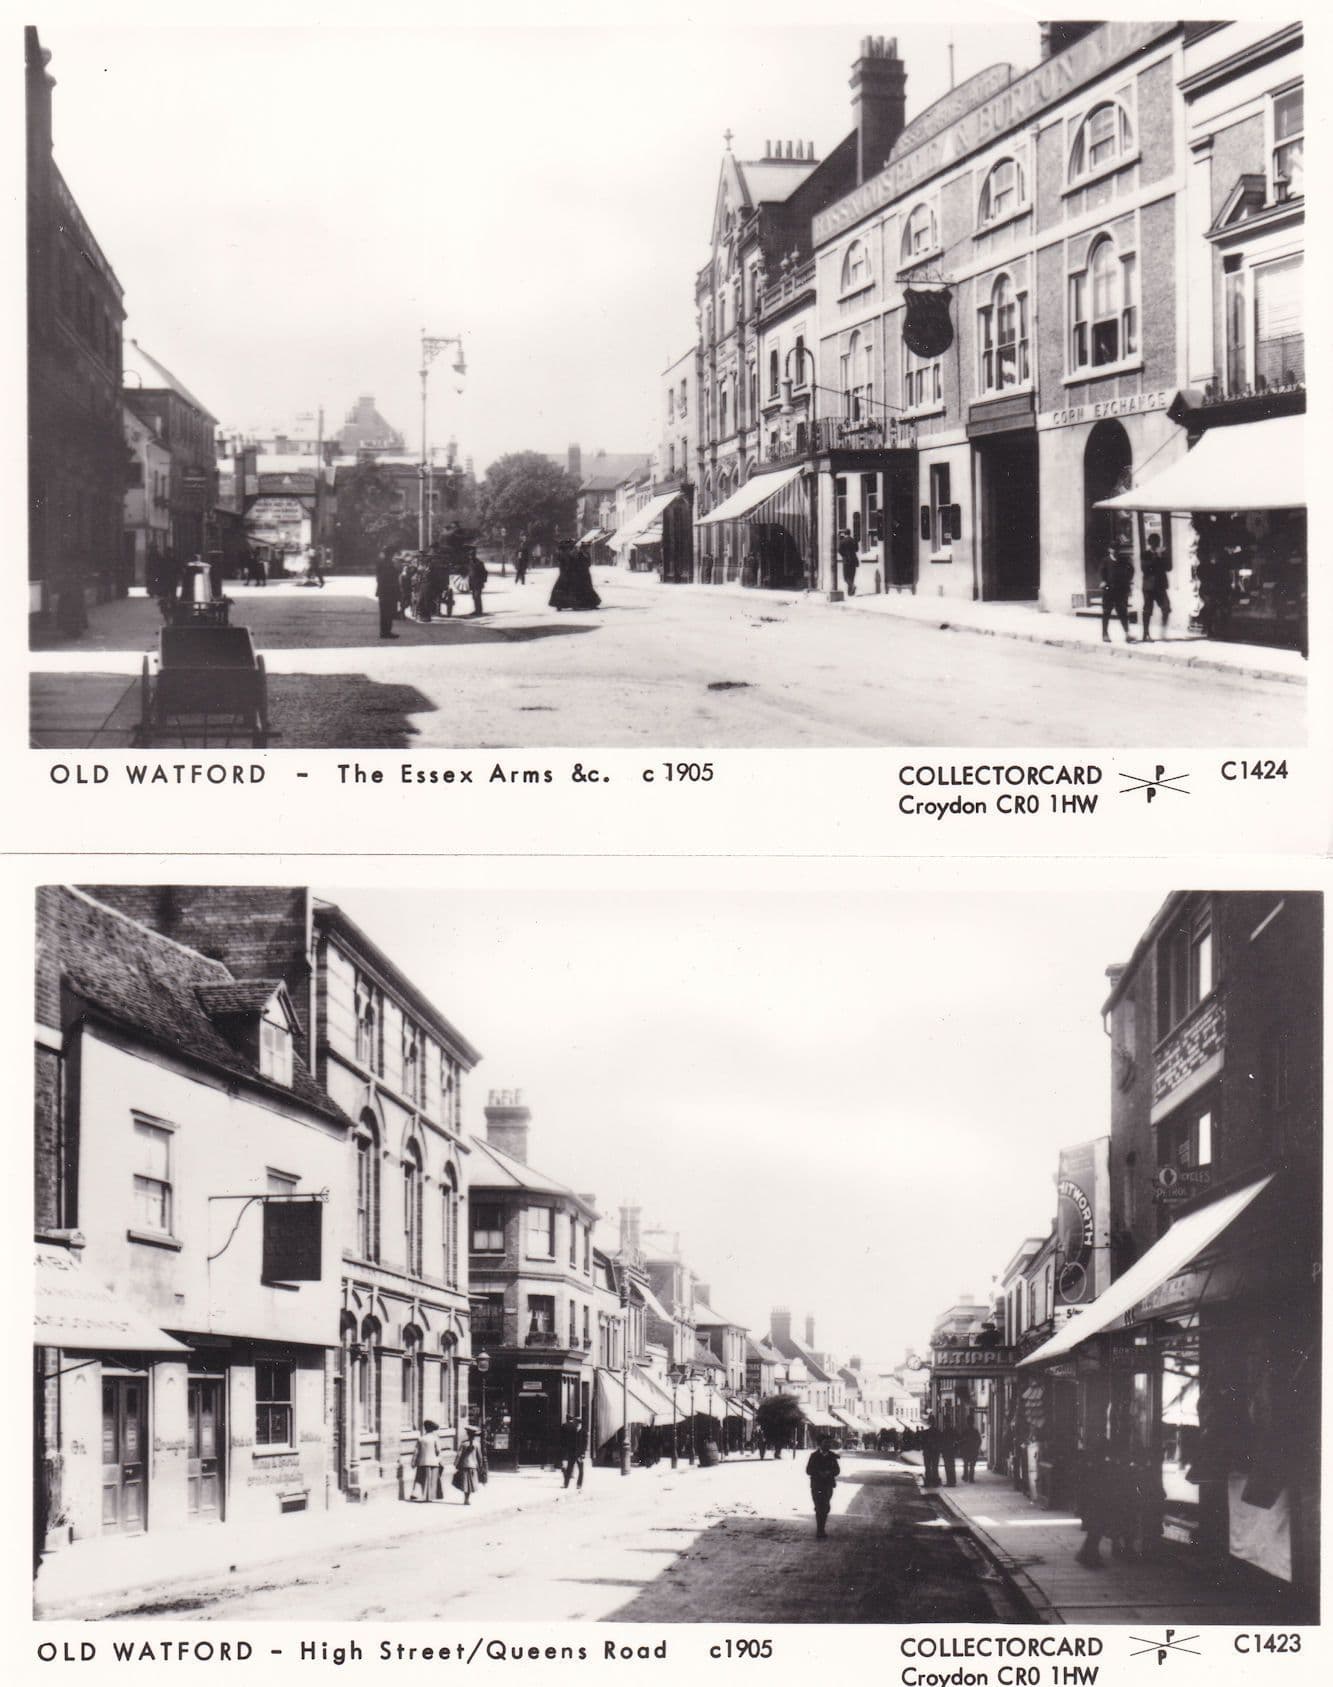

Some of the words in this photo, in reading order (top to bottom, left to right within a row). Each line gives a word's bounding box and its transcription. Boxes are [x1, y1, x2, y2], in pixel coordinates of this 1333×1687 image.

[981, 54, 1075, 137] BURTON
[1052, 408, 1084, 425] CORN
[1094, 391, 1166, 418] EXCHANGE
